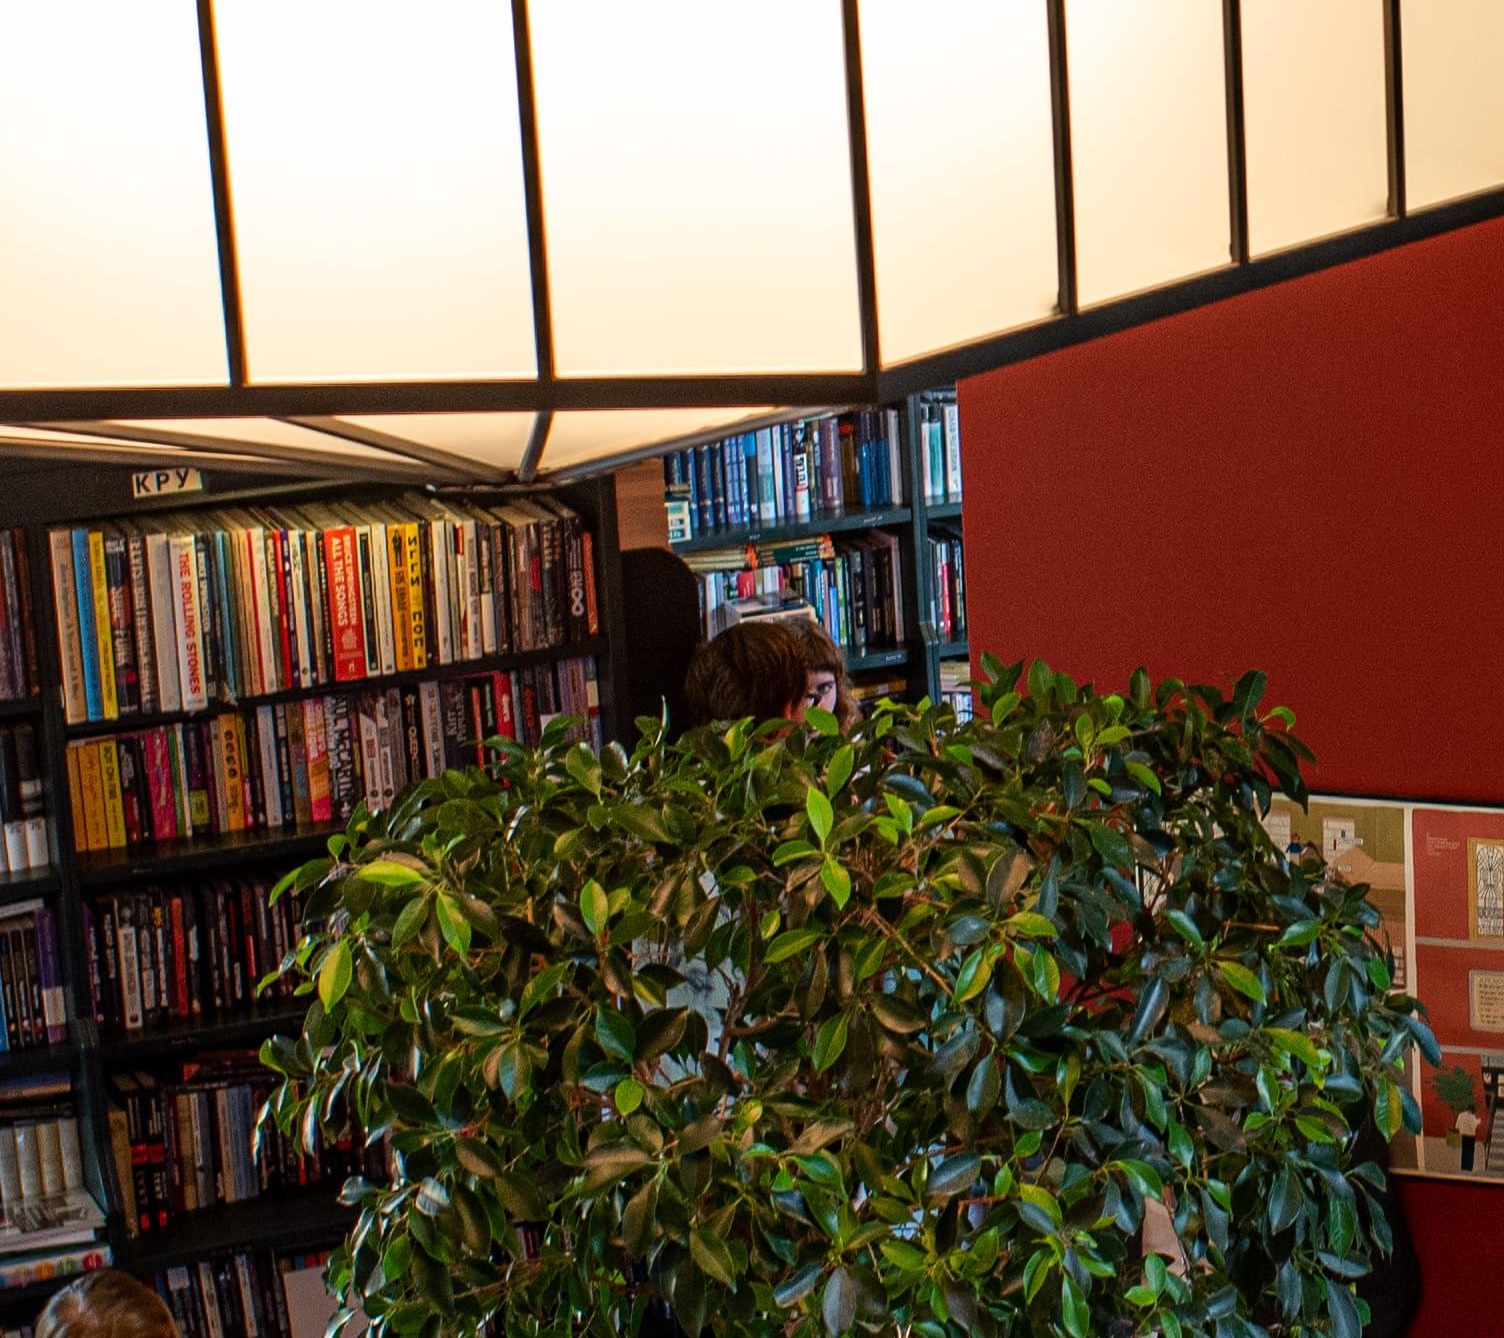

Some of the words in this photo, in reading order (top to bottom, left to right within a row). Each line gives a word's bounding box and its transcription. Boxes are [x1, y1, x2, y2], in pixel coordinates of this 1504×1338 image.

[134, 469, 191, 494] КРУ
[178, 552, 190, 577] THE
[331, 537, 340, 559] ALL
[407, 536, 421, 587] ИГГИ
[334, 562, 343, 582] THE
[181, 578, 195, 640] ROLLING
[337, 586, 349, 627] SONGS
[412, 612, 425, 648] ПОП
[186, 643, 202, 695] STONES
